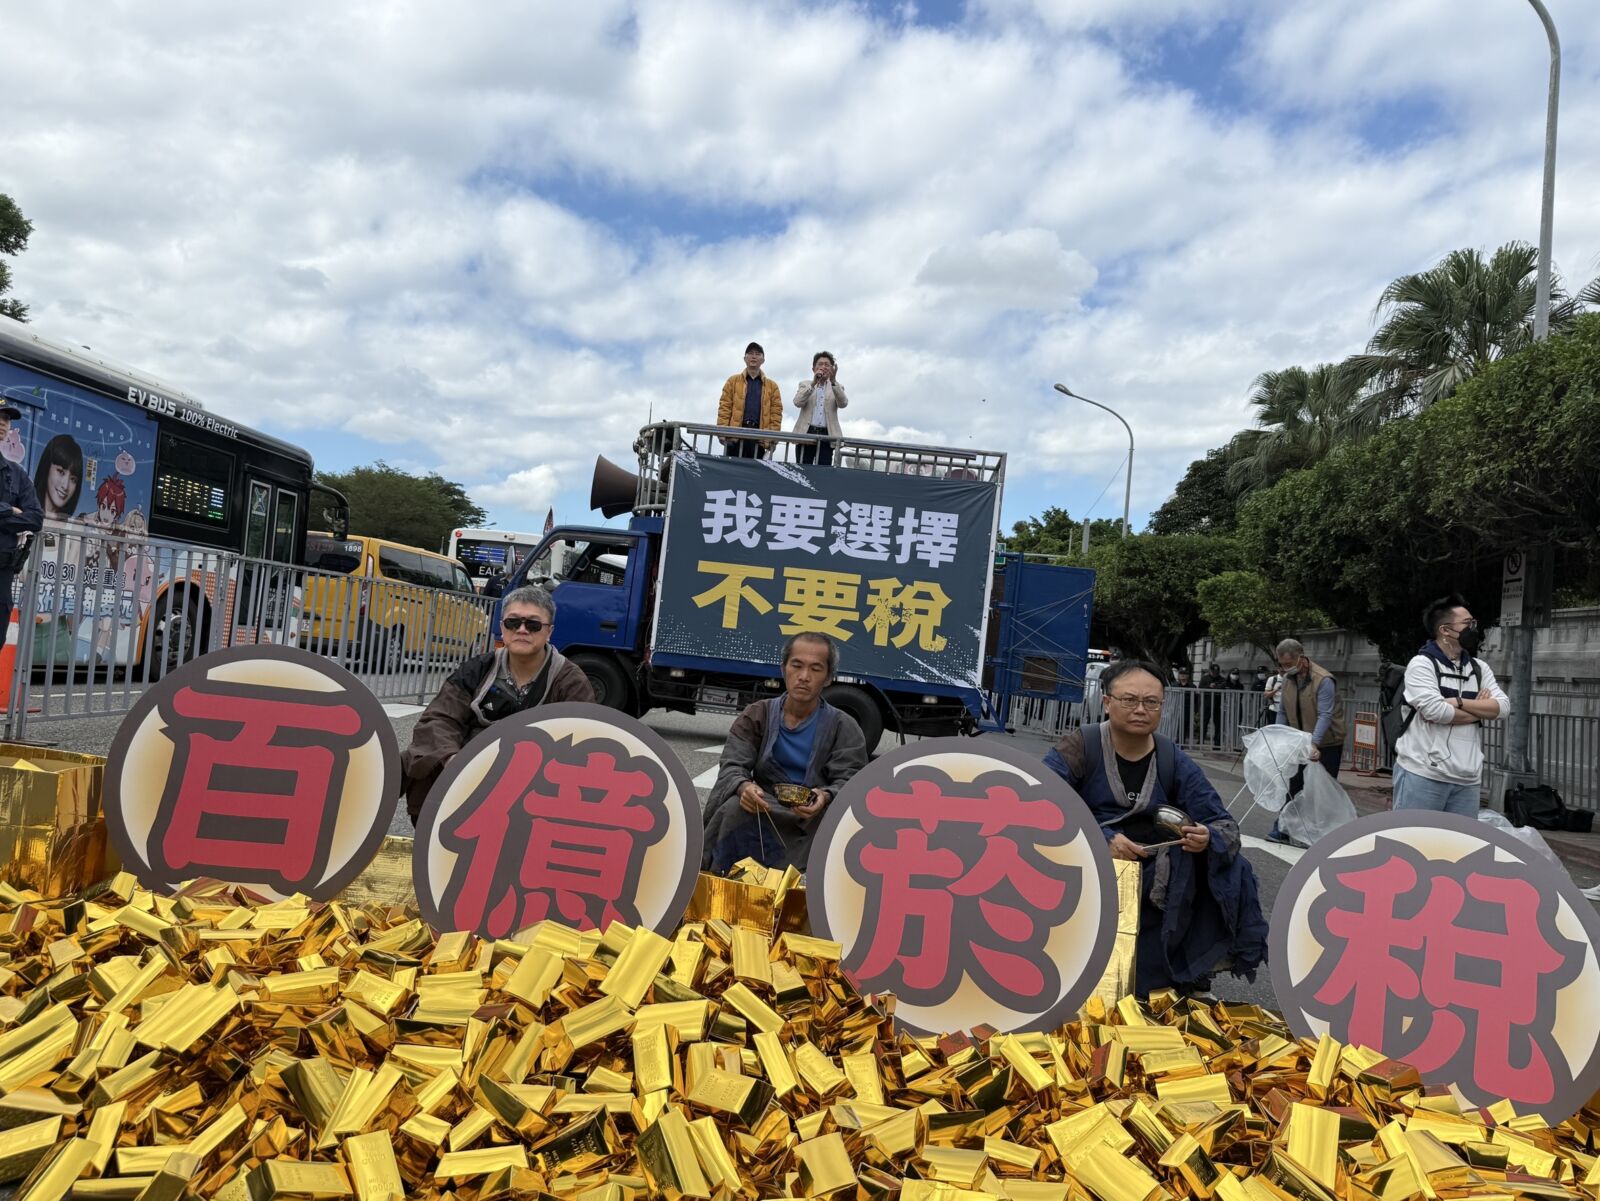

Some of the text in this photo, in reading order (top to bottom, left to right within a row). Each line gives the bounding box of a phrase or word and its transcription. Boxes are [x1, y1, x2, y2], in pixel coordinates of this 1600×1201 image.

[128, 386, 147, 405] EV
[148, 394, 177, 417] BUS
[180, 408, 205, 427] 100%
[206, 417, 239, 439] Electric
[344, 545, 362, 553] 1898
[701, 489, 960, 569] 我要選擇
[691, 559, 952, 653] 不要稅
[162, 685, 362, 883] 百
[453, 740, 655, 938] 億
[856, 779, 1065, 997] 菸
